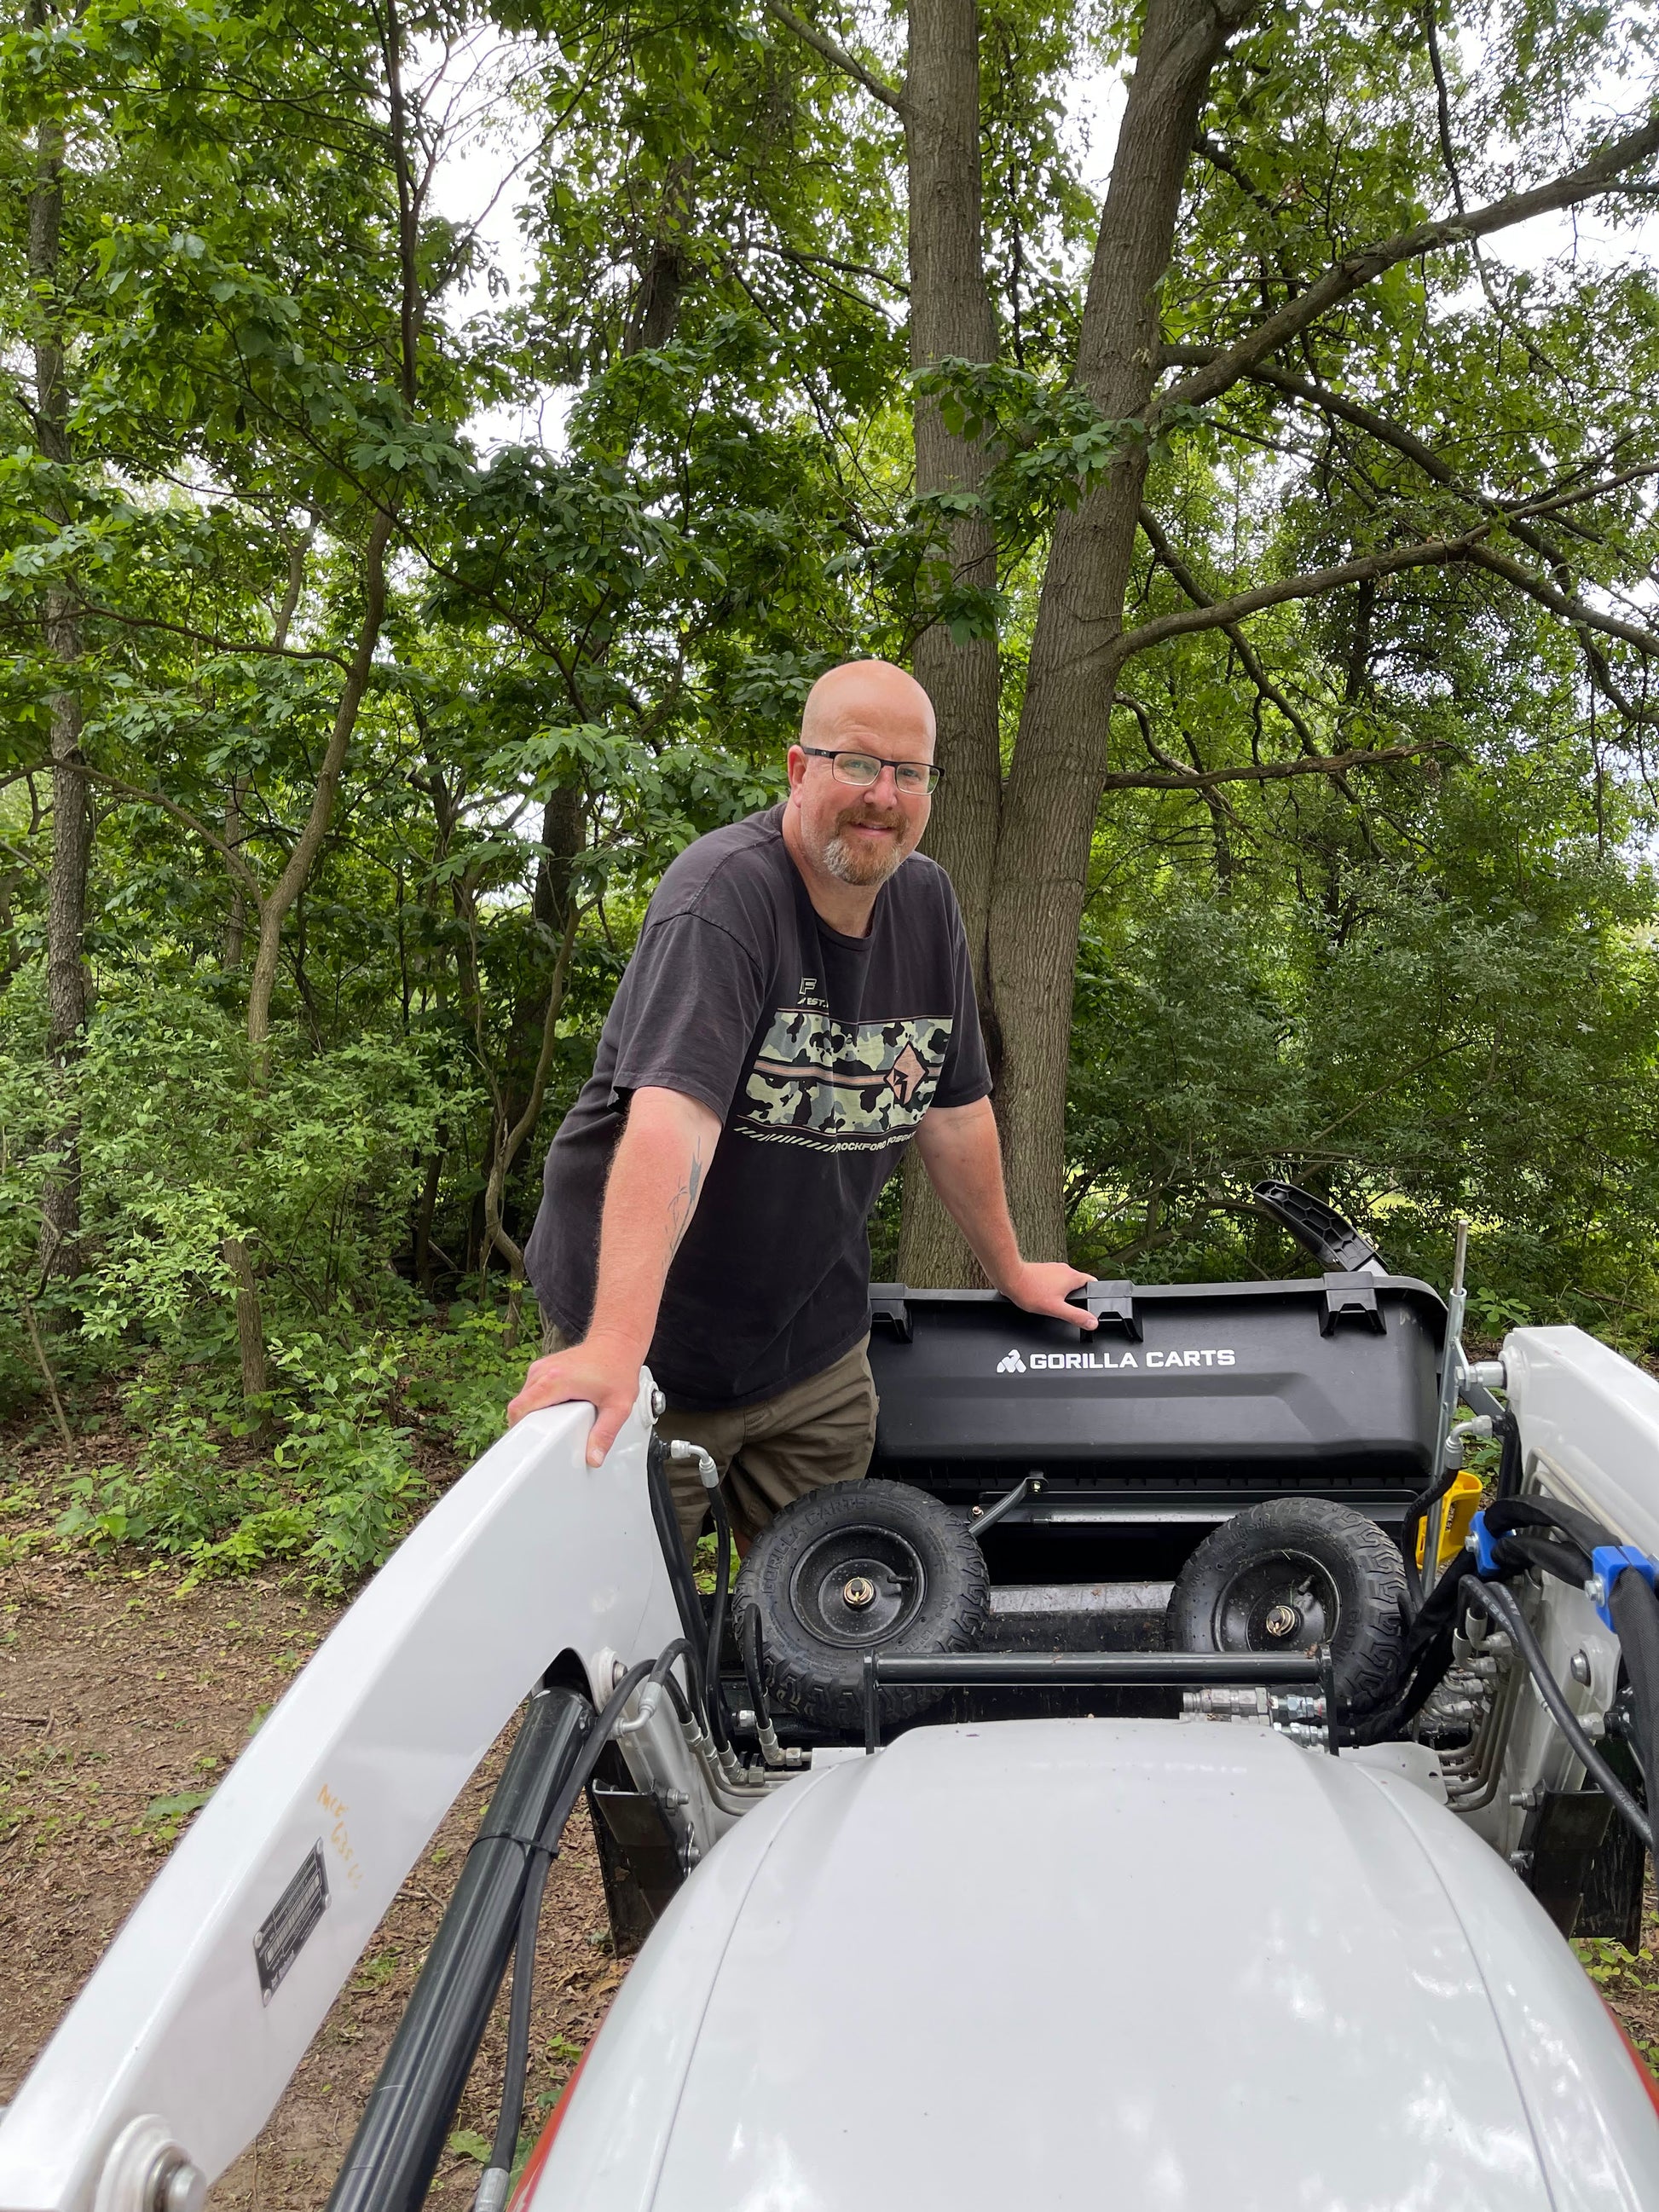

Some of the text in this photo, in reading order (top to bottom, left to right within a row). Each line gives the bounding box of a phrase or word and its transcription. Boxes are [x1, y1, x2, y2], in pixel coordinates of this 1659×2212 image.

[835, 1140, 887, 1152] ROCKFORD
[1030, 1349, 1235, 1369] GORILLA CARTS
[761, 1525, 807, 1594] GORILLA
[804, 1496, 868, 1526] CARTS
